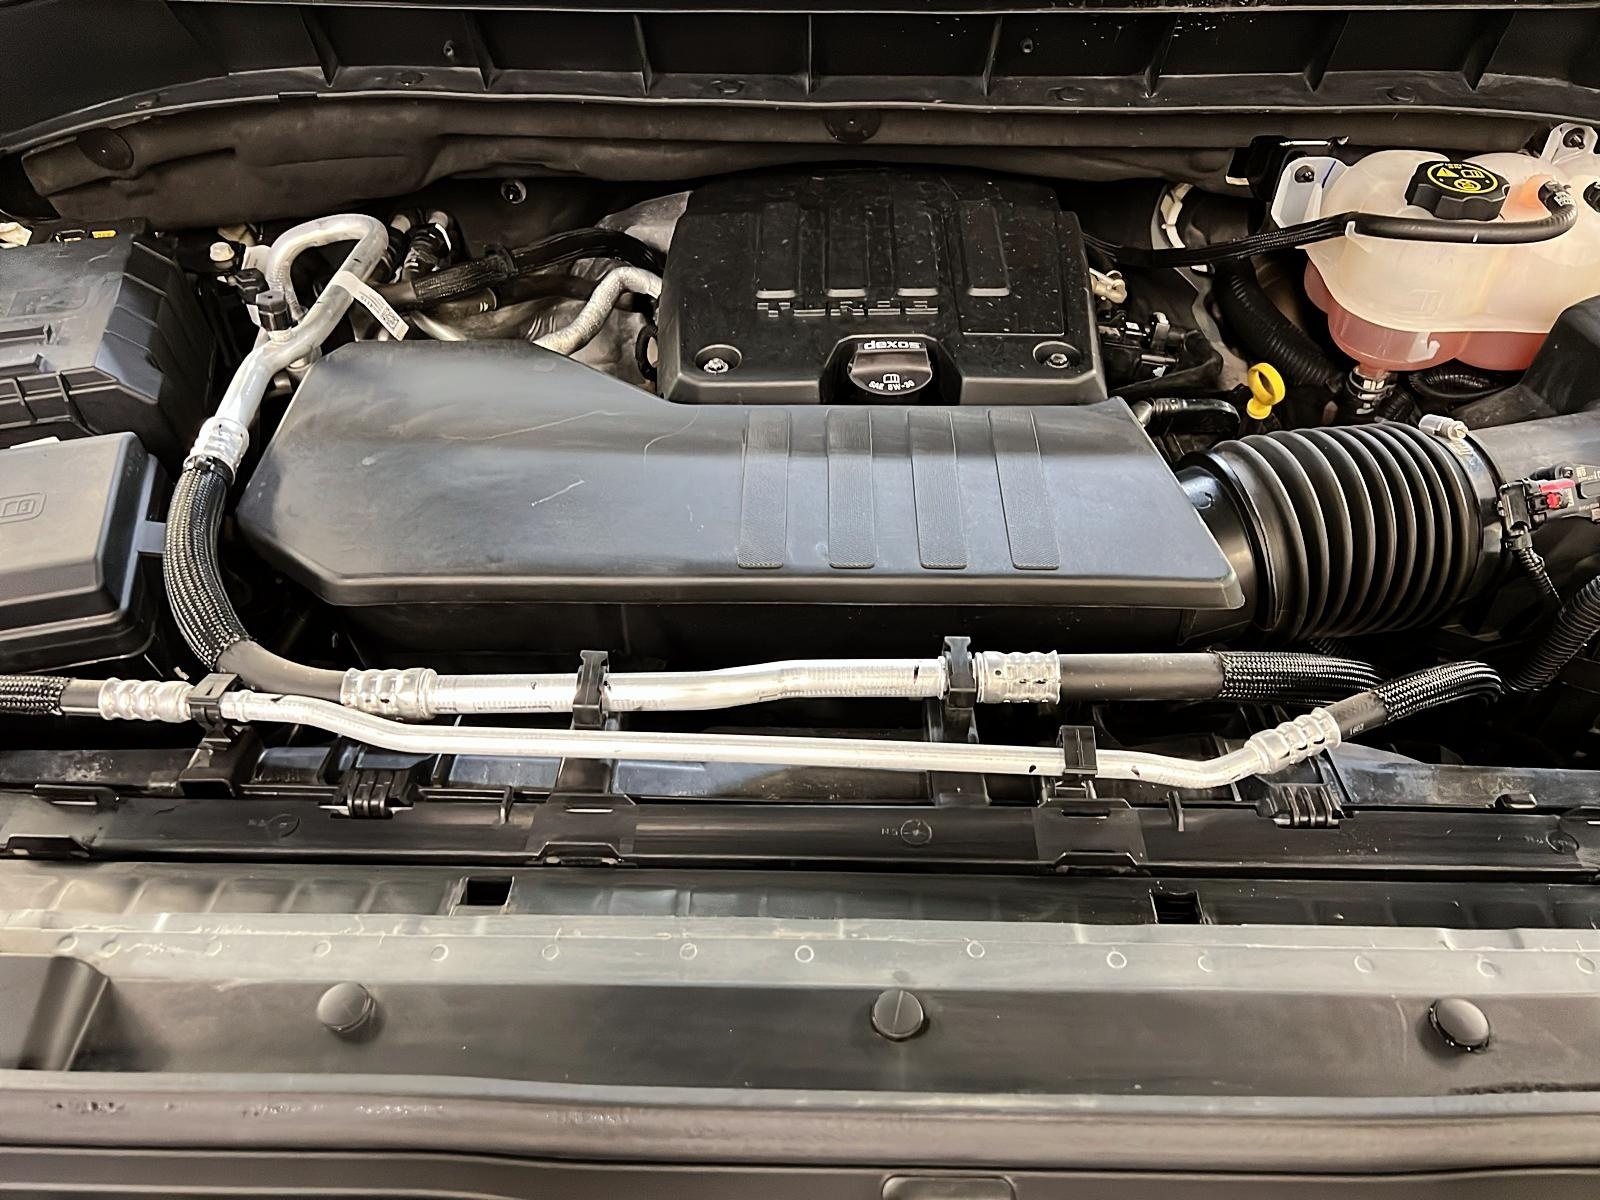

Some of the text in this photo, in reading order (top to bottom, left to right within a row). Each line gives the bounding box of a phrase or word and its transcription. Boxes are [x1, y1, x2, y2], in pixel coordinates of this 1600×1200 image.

[863, 340, 922, 350] dexos
[868, 379, 916, 391] SAE 5W-30
